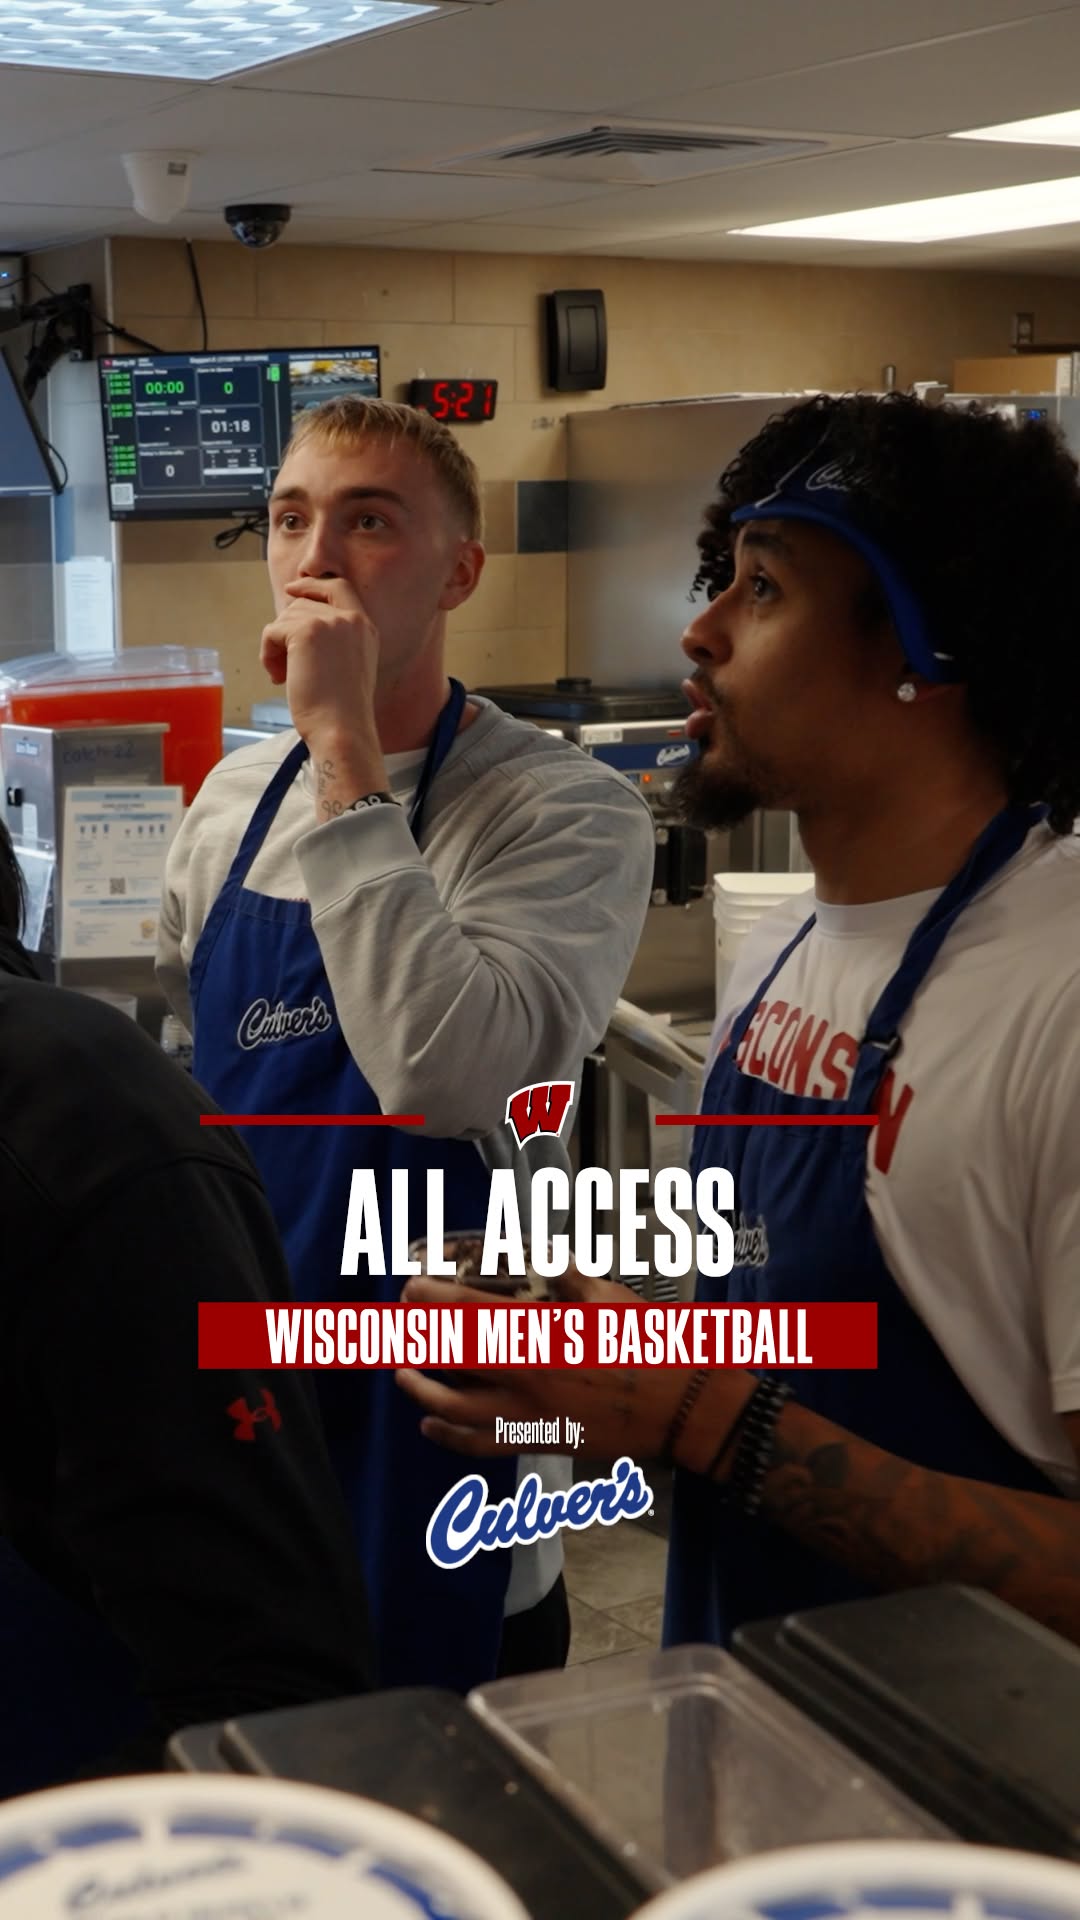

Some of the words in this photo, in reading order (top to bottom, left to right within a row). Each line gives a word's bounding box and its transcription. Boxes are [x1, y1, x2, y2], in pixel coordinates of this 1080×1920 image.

[145, 381, 185, 395] 00:00
[223, 381, 234, 395] 0
[432, 382, 493, 419] 5:21
[211, 420, 251, 434] 01:18
[165, 464, 176, 478] 0
